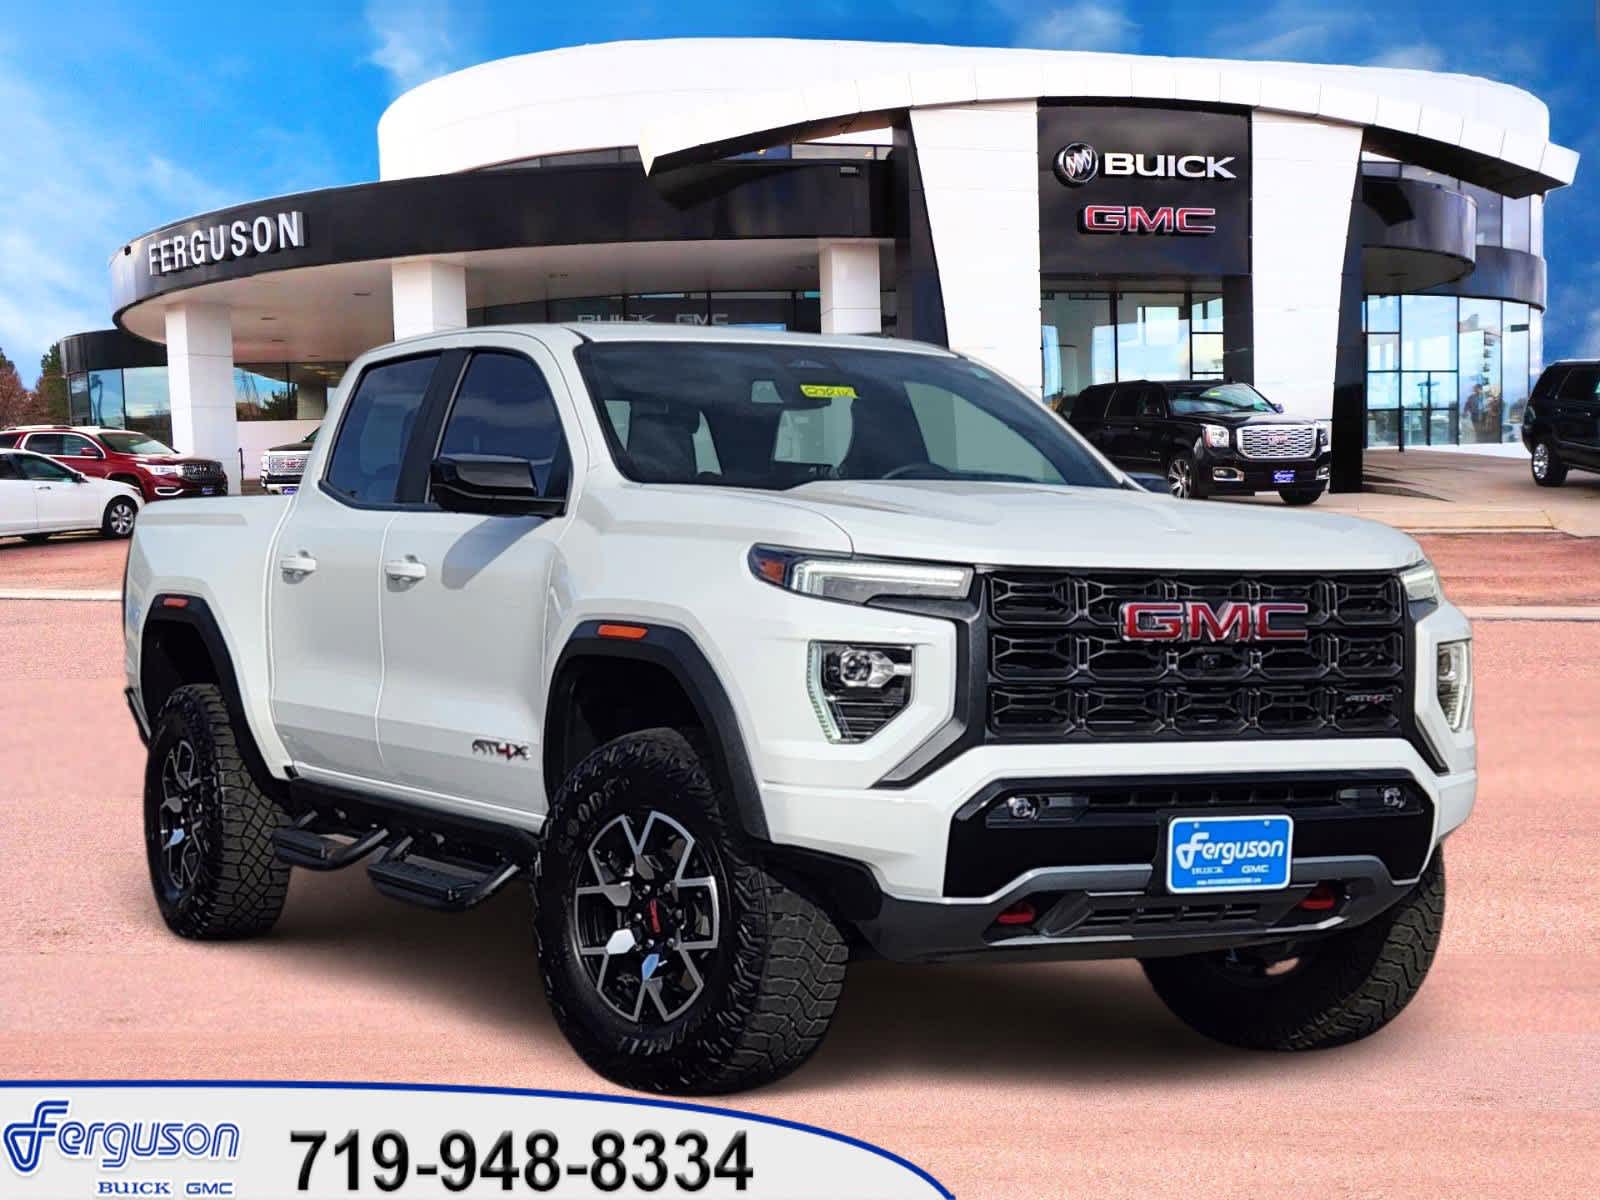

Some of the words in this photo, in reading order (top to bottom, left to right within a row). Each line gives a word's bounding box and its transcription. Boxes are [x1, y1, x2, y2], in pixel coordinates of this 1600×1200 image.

[1104, 152, 1237, 179] BUICK
[1084, 205, 1216, 233] GMC
[149, 211, 304, 276] FERGUSON
[1121, 601, 1308, 641] GMC
[472, 739, 529, 761] AT4X
[1176, 832, 1285, 869] Ferguson
[1241, 864, 1270, 874] GMC
